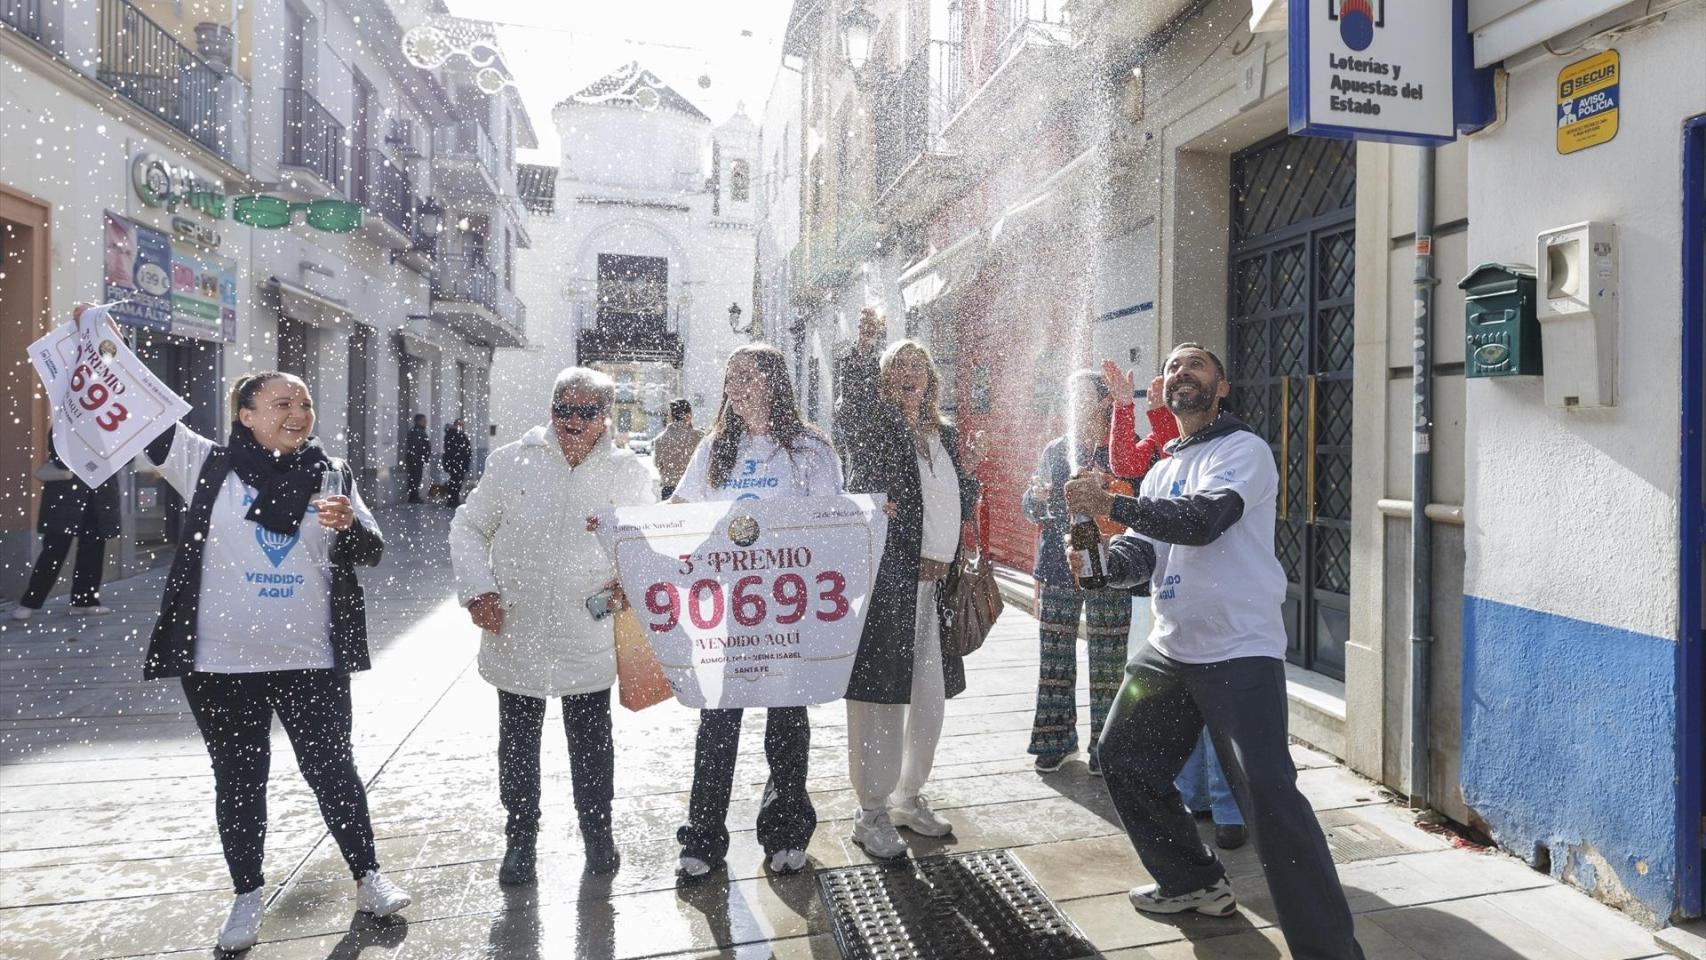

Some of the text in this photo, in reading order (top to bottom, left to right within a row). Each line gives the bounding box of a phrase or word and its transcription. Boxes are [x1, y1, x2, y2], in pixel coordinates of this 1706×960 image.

[1329, 53, 1401, 80] Loterías y
[1575, 64, 1615, 88] SECUR
[1331, 75, 1423, 100] Apuestas del
[1330, 95, 1381, 115] Estado
[1580, 92, 1605, 108] AVISO
[708, 546, 812, 573] PREMIO
[246, 572, 304, 585] VENDIDO
[645, 570, 850, 633] 90693
[696, 633, 760, 650] VENDIDO
